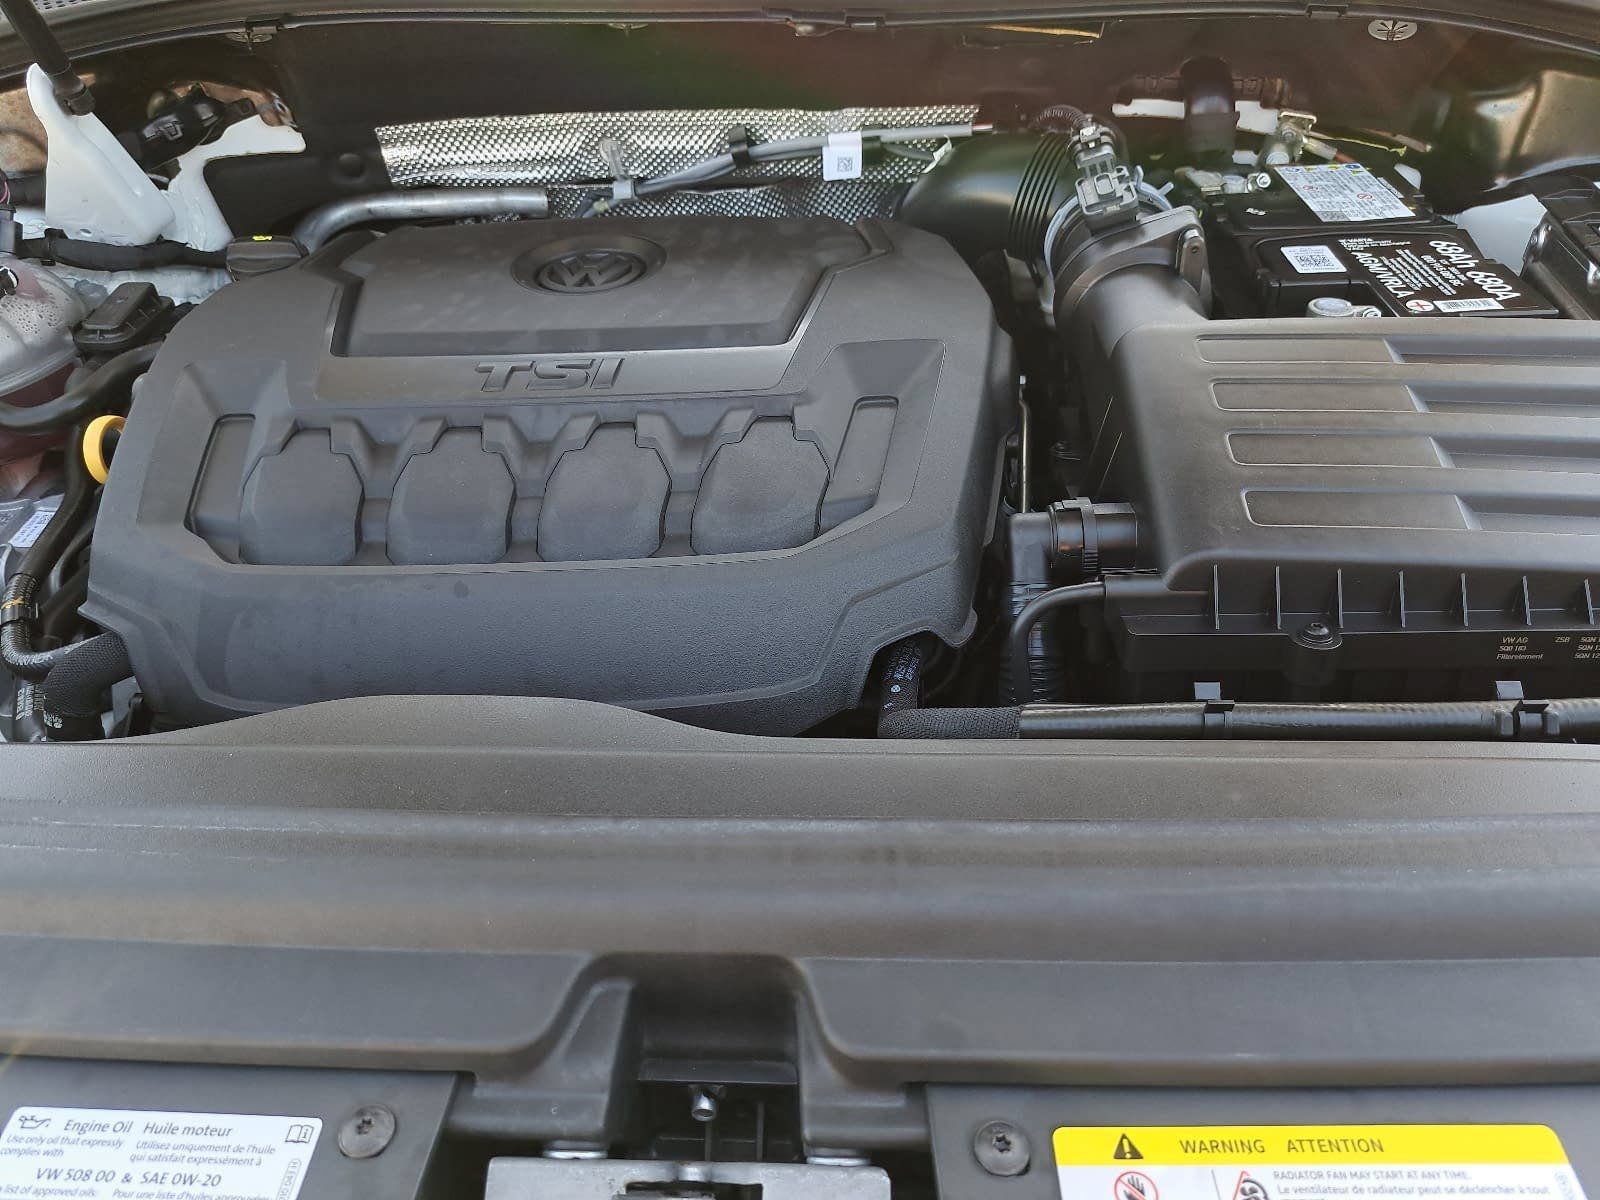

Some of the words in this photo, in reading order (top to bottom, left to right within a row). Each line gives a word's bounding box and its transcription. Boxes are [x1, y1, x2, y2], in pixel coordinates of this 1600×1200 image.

[1351, 252, 1415, 298] AGM/VRLA
[1429, 240, 1479, 269] 68Ah
[1466, 270, 1522, 301] 680A
[476, 357, 626, 393] TSI
[64, 1119, 110, 1135] Engine
[112, 1120, 134, 1133] Oil
[143, 1121, 179, 1135] Huile
[181, 1125, 234, 1137] moteur
[6, 1135, 24, 1144] Use
[25, 1136, 46, 1146] only
[47, 1136, 60, 1145] oil
[60, 1136, 80, 1146] that
[81, 1138, 124, 1149] expressly
[136, 1140, 171, 1150] Utilisez
[172, 1142, 231, 1153] uniquement
[232, 1144, 245, 1153] de
[246, 1144, 276, 1154] l'huile
[1179, 1139, 1265, 1154] WARNING
[1287, 1138, 1385, 1153] ATTENTION
[0, 1147, 40, 1157] complies
[42, 1147, 65, 1157] with
[129, 1152, 147, 1163] qui
[147, 1152, 186, 1163] satisfait
[186, 1154, 254, 1166] expressément
[255, 1158, 263, 1166] à
[36, 1167, 63, 1181] VW
[64, 1168, 93, 1182] 508
[95, 1169, 116, 1183] 00
[121, 1172, 133, 1183] &
[140, 1171, 169, 1184] SAE
[171, 1172, 222, 1187] 0W-20
[1272, 1170, 1323, 1180] RADIATOR
[1326, 1170, 1348, 1180] FAN
[1349, 1170, 1371, 1180] MAY
[1373, 1170, 1404, 1180] START
[1407, 1170, 1419, 1180] AT
[1421, 1170, 1442, 1180] ANY
[4, 1184, 20, 1194] list
[20, 1184, 33, 1195] of
[32, 1186, 78, 1198] approved
[112, 1188, 135, 1198] Pour
[135, 1190, 155, 1199] une
[155, 1189, 176, 1200] liste
[1277, 1184, 1290, 1194] Le
[1293, 1184, 1350, 1194] ventilateur
[1352, 1184, 1365, 1194] de
[1367, 1184, 1415, 1194] radiateur
[1417, 1185, 1441, 1196] peut
[1443, 1186, 1456, 1194] se
[1526, 1185, 1550, 1194] tout
